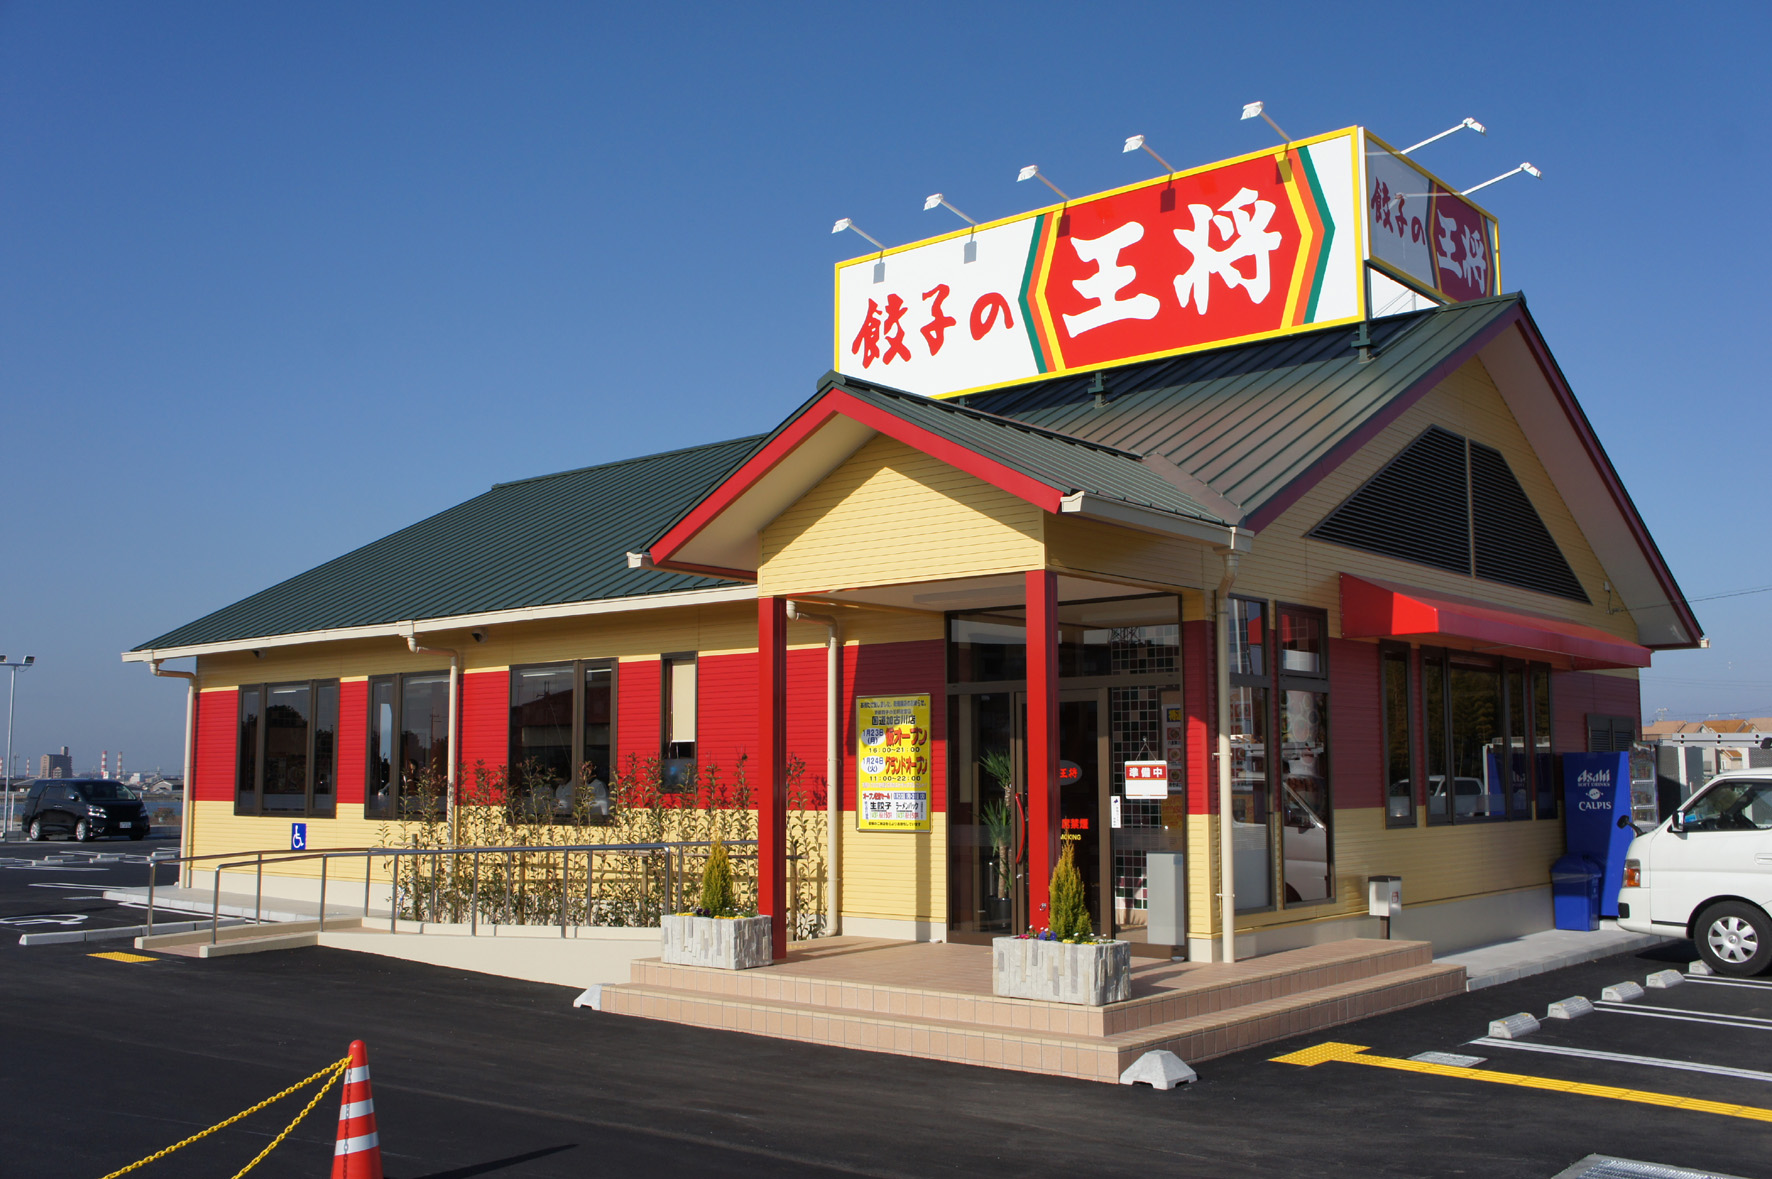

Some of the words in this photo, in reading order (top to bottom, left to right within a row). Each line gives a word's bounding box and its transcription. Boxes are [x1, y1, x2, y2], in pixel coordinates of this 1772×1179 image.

[872, 714, 916, 726] 国道加古川店
[862, 729, 884, 737] 1月23日
[862, 757, 884, 765] 1月24日
[886, 756, 927, 775] グランドオープン
[867, 765, 878, 773] (火)
[1060, 767, 1078, 778] 王将
[1577, 769, 1610, 783] Asahi
[1578, 801, 1612, 811] CALPIS
